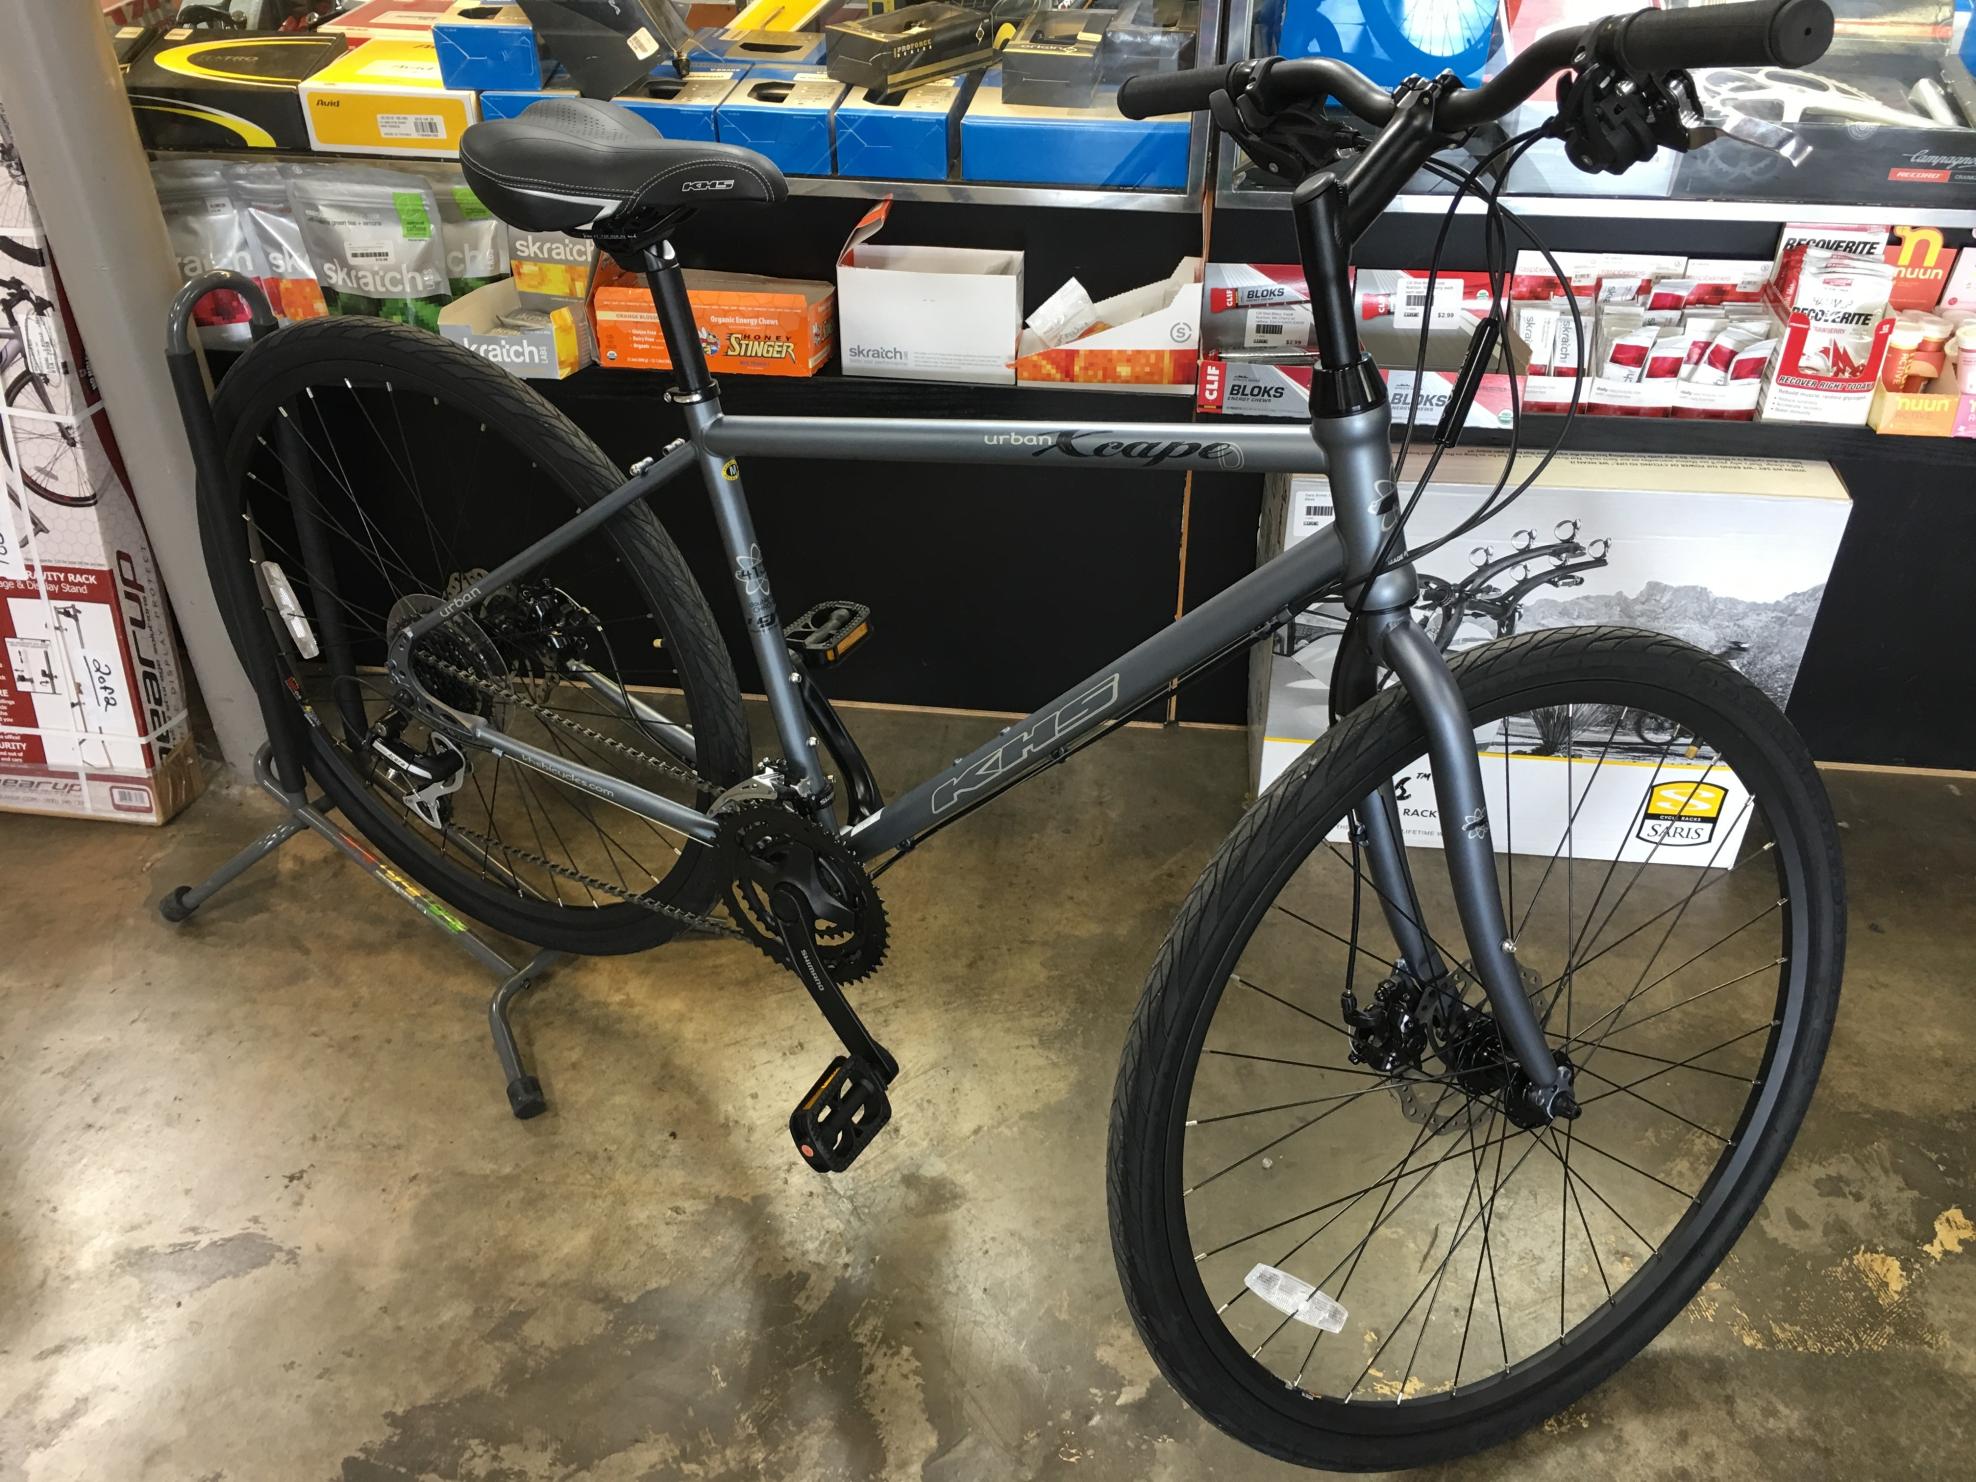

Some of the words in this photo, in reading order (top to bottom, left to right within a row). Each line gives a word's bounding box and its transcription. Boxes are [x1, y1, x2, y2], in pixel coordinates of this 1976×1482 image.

[316, 99, 341, 107] Avid
[1896, 171, 1942, 179] RECORD
[681, 179, 735, 192] KHS
[323, 257, 423, 293] skratch
[1894, 266, 1943, 280] nuun
[1247, 287, 1285, 299] BLOKS
[710, 315, 735, 324] Organic
[735, 316, 758, 326] Energy
[759, 317, 778, 325] Chews
[743, 334, 791, 342] HONEY
[1560, 320, 1571, 361] skratch
[463, 337, 539, 364] kratch
[726, 333, 797, 364] STINGER
[848, 345, 903, 360] skratch
[1205, 365, 1219, 400] CLIF
[1779, 375, 1818, 387] RECOVER
[1818, 379, 1845, 390] RIGHT
[1229, 384, 1285, 399] BLOKS
[1391, 392, 1448, 407] BLOKS
[1896, 396, 1949, 413] nuun
[983, 431, 1052, 446] urban
[1031, 429, 1233, 467] Xcape
[67, 573, 98, 585] RACK
[16, 580, 26, 590] &
[26, 580, 60, 594] Dislay
[60, 582, 88, 594] Stand
[439, 587, 482, 619] urban
[0, 741, 27, 751] URITY
[931, 672, 1120, 815] KHS
[521, 753, 615, 799] khsbicycles.com
[1416, 772, 1432, 782] TM
[1402, 808, 1438, 819] RACK
[1402, 829, 1436, 837] LIFETIME
[1646, 823, 1705, 840] SARIS
[800, 947, 825, 993] SHIMANO
